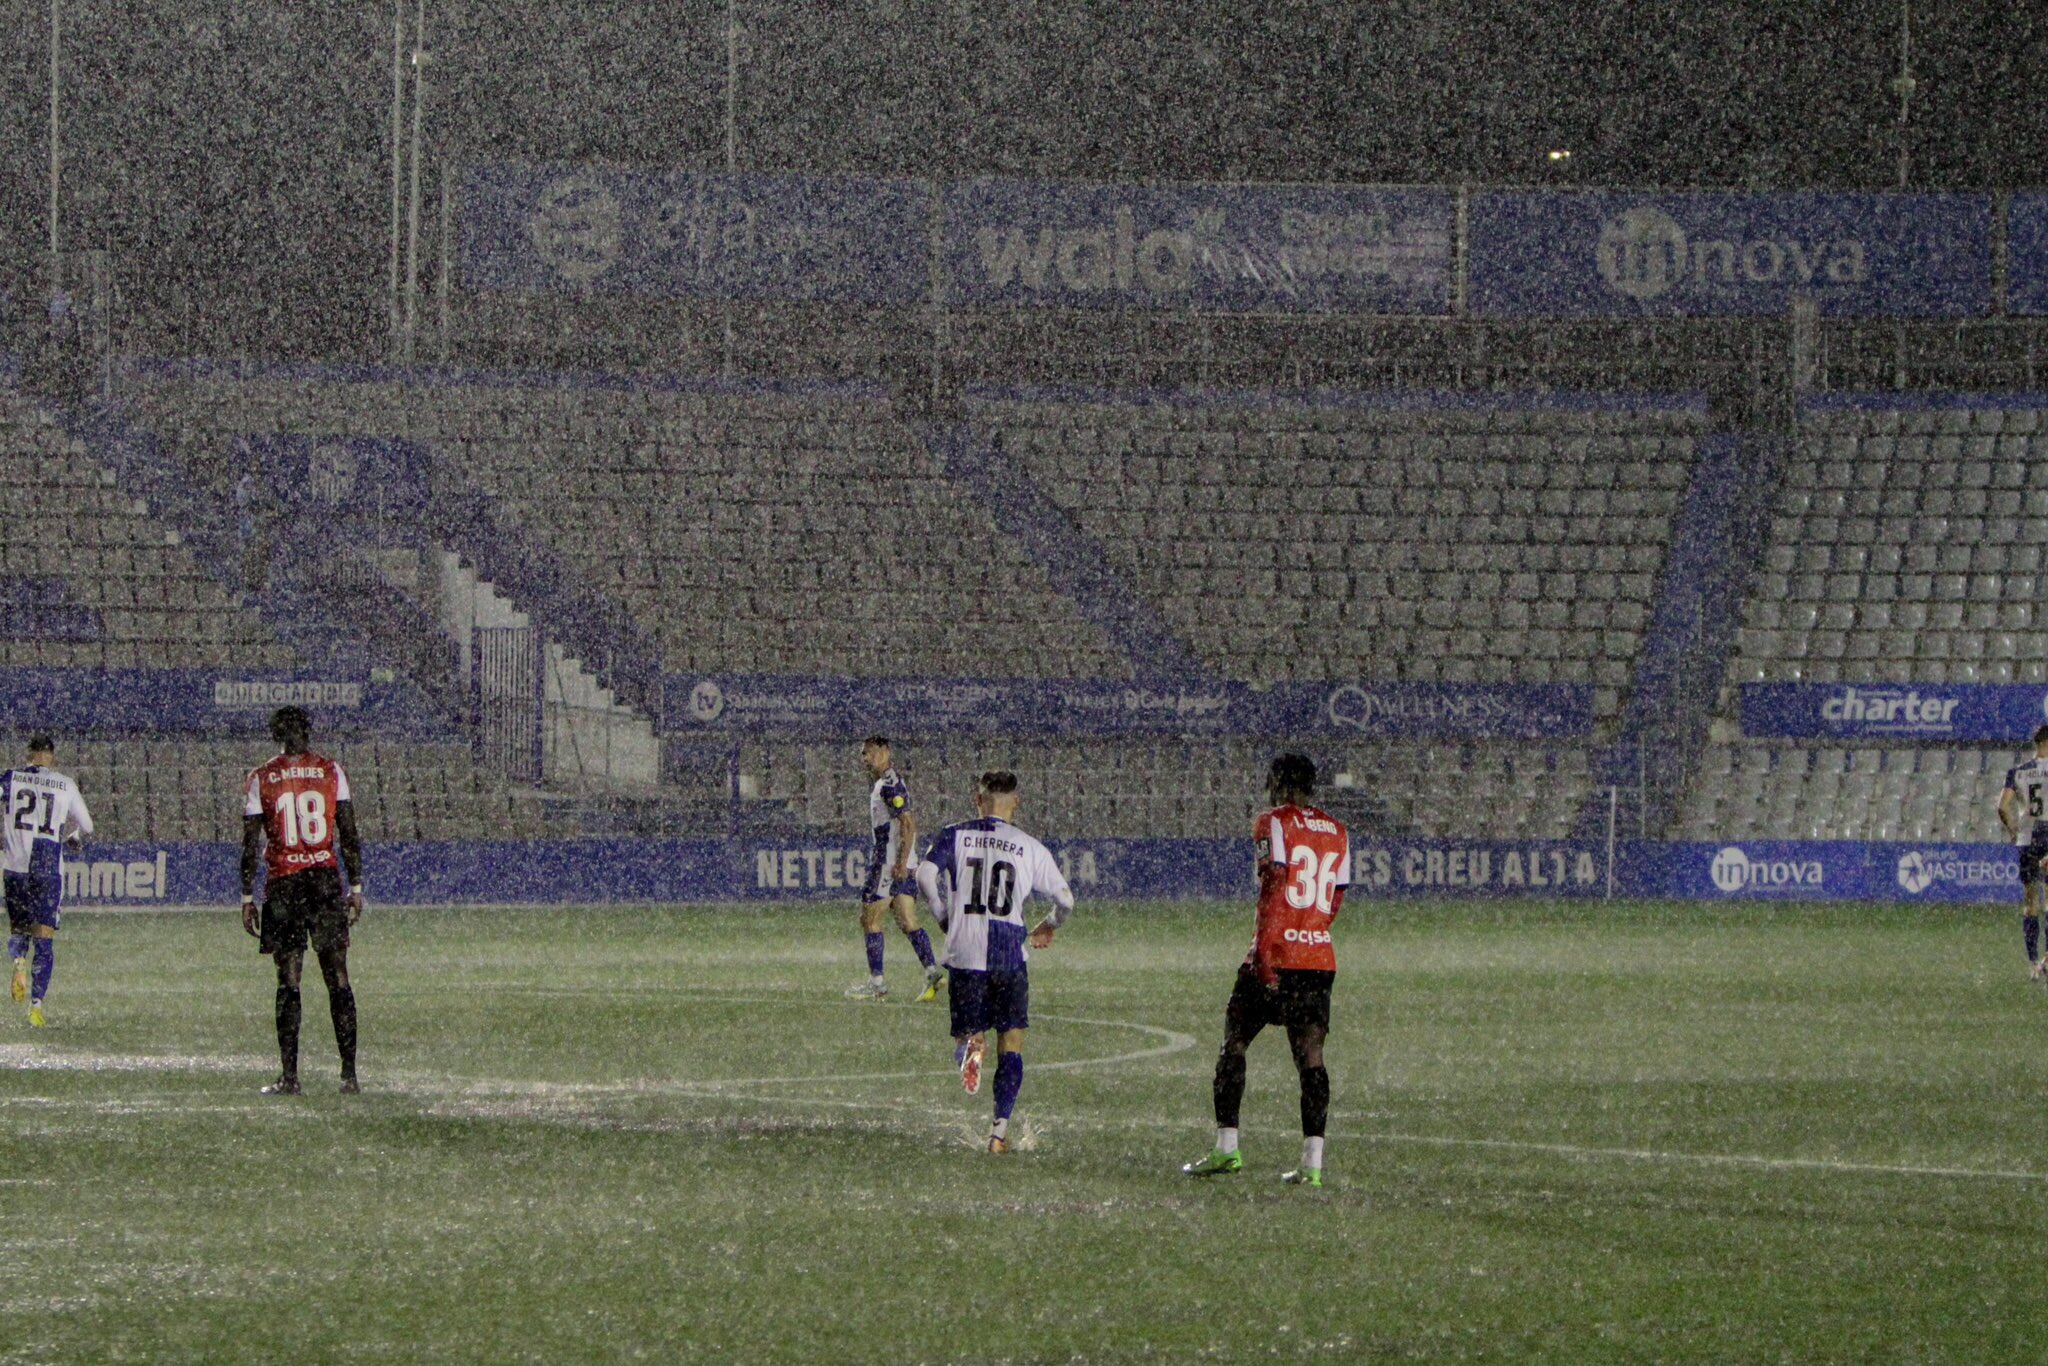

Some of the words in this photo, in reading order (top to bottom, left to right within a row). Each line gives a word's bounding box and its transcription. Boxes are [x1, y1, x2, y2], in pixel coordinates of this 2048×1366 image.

[1822, 687, 1959, 722] charter
[281, 766, 325, 779] MENDES
[15, 788, 55, 836] 21
[276, 790, 327, 847] 18
[2028, 783, 2043, 817] 5
[964, 856, 1017, 917] 10
[1286, 844, 1340, 914] 36
[1404, 848, 1491, 885] CREU
[1503, 849, 1597, 887] ALTA
[1712, 849, 1823, 888] innova
[1284, 929, 1332, 946] ocisa
